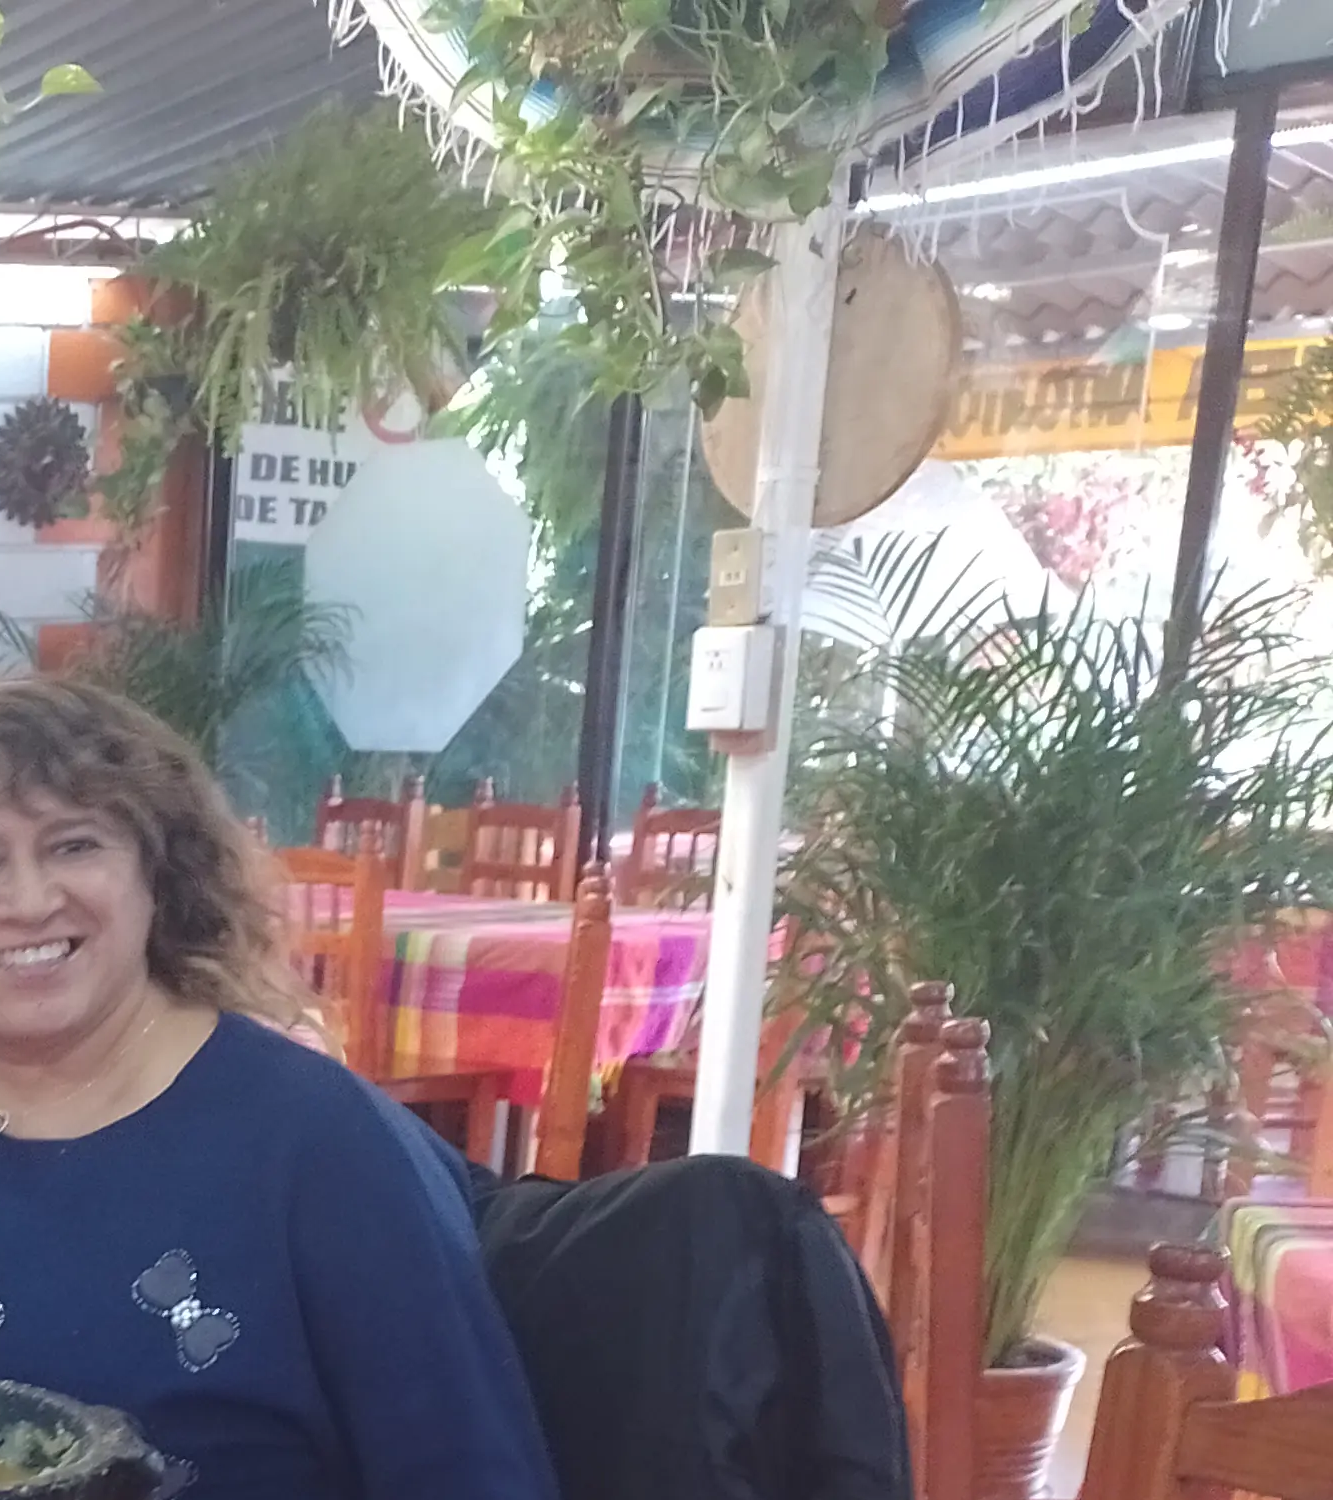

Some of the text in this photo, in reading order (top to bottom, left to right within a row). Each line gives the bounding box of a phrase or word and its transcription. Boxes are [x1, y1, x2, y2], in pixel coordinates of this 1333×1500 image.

[249, 452, 358, 488] DE HU
[234, 494, 328, 527] DE TA
